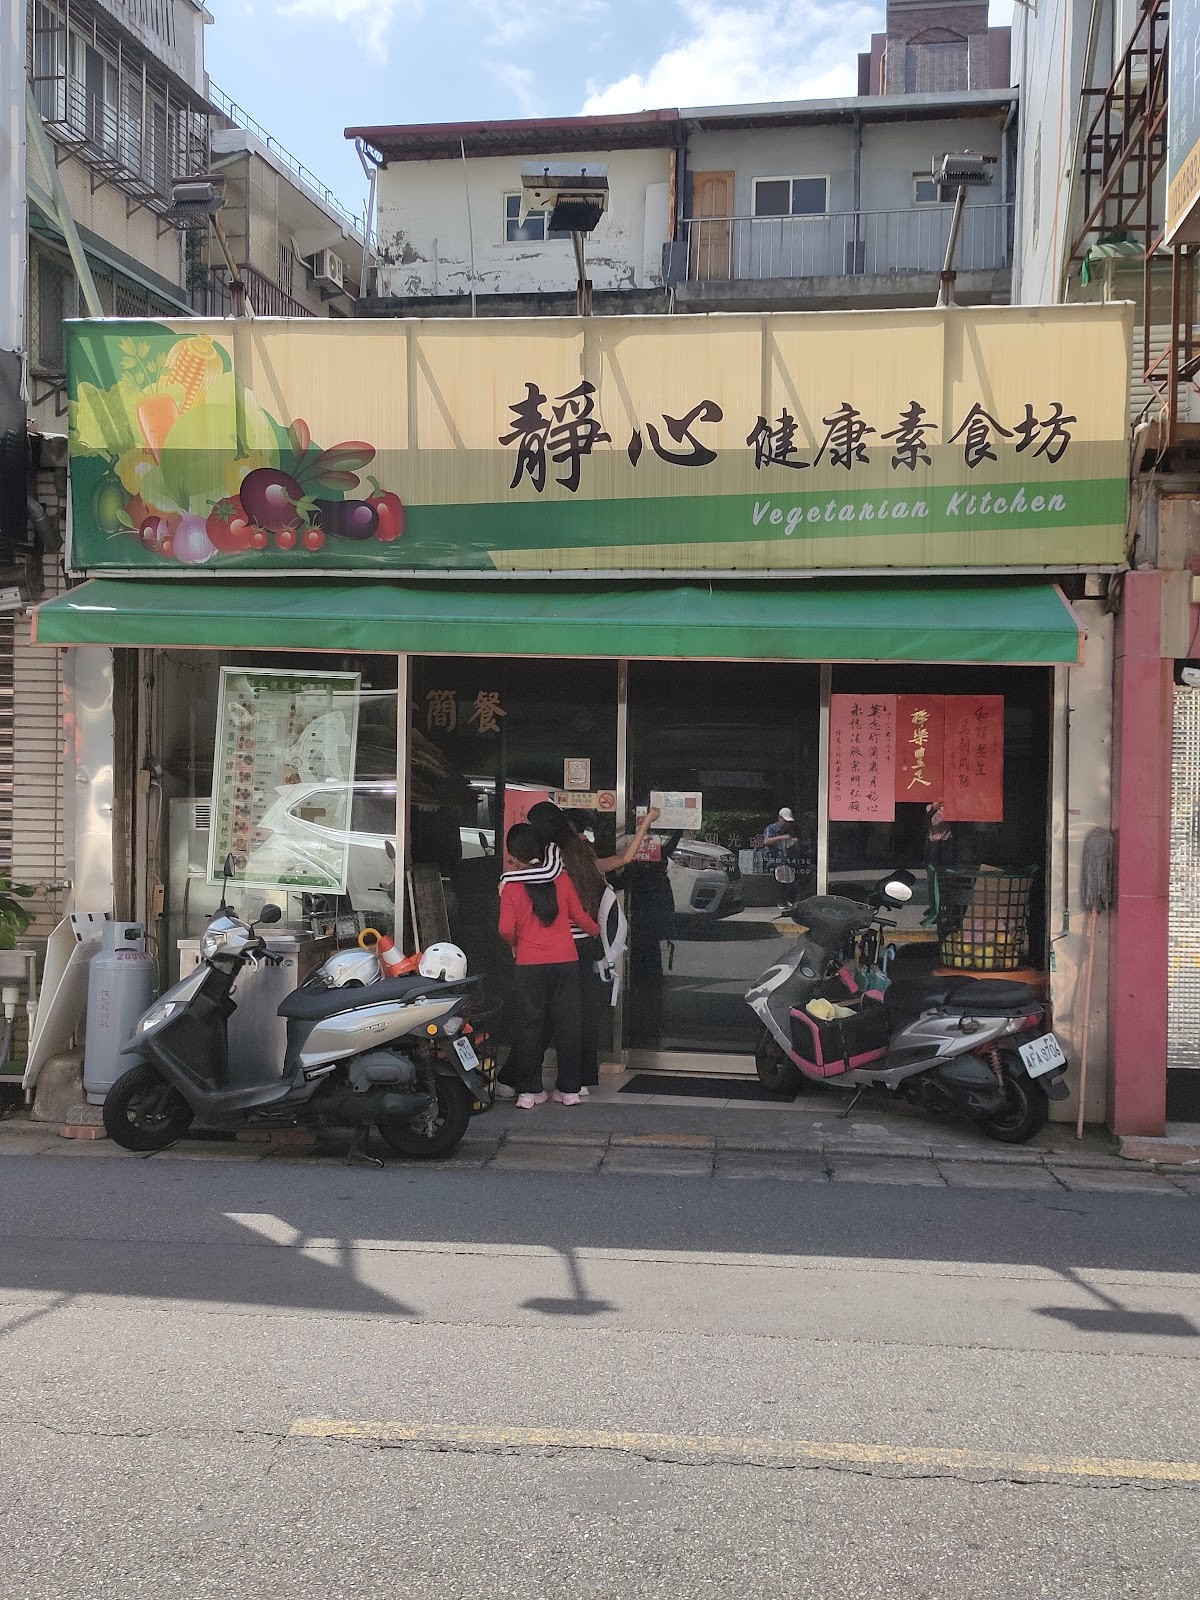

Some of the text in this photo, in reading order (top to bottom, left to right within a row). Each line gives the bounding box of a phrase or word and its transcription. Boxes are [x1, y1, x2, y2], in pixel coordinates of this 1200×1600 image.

[498, 380, 1078, 494] 靜心 健康素食坊
[752, 486, 1067, 536] Vegetarian Kitchen
[426, 689, 508, 733] 簡餐
